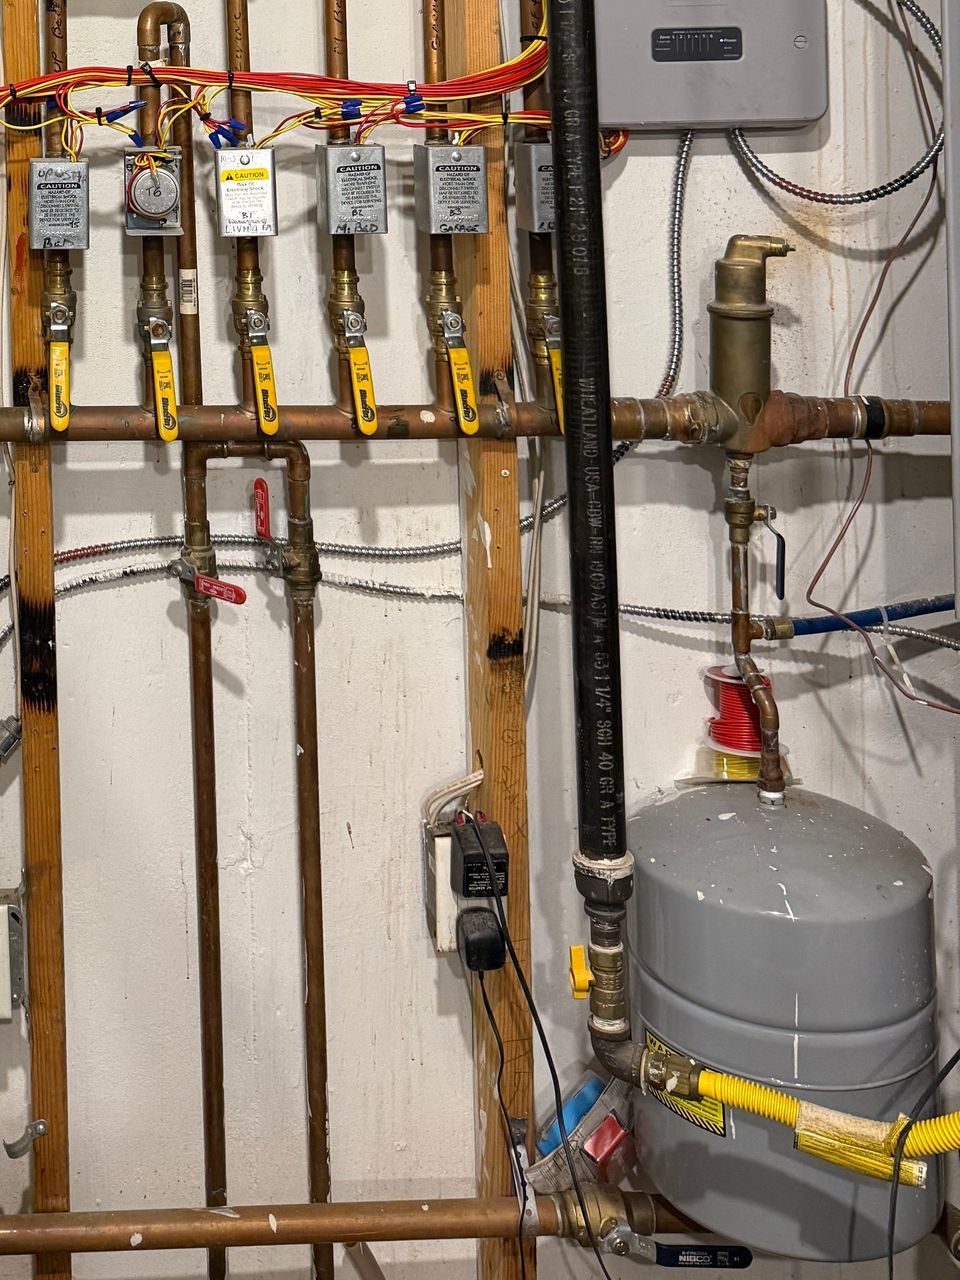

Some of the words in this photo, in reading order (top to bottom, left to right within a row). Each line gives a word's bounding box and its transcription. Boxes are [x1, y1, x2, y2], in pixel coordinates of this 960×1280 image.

[145, 186, 162, 197] T6
[598, 750, 615, 771] 40
[599, 776, 615, 794] GR
[601, 816, 617, 846] TYPE
